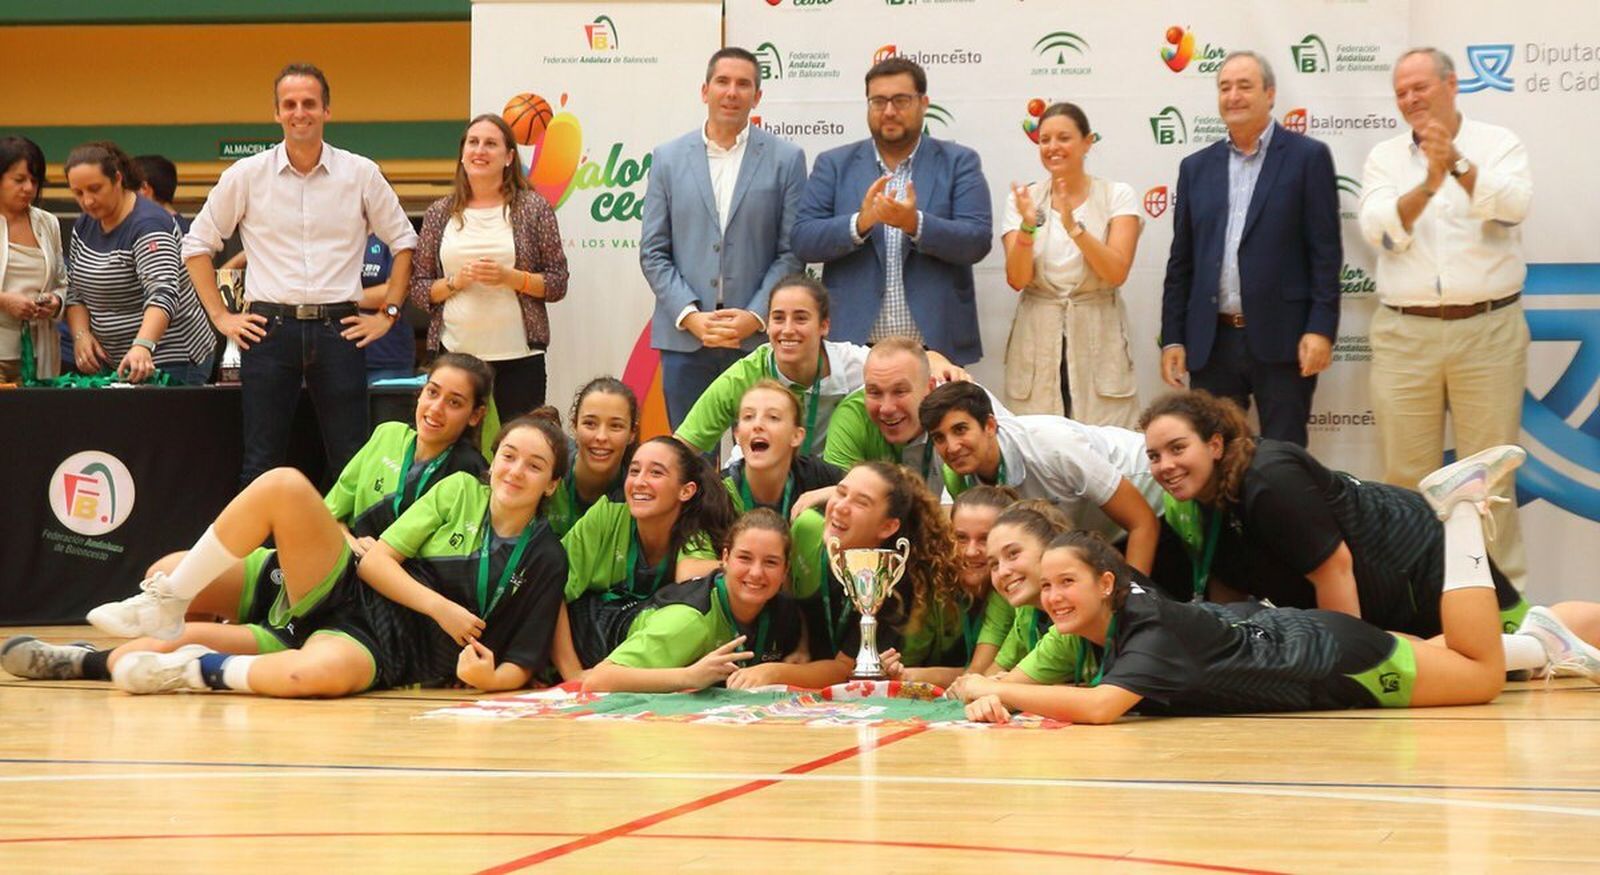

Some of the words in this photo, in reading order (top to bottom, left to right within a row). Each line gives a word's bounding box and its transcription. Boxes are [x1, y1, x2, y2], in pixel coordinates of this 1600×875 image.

[1336, 43, 1380, 53] Federación
[788, 51, 830, 59] Federación
[1336, 54, 1376, 62] Andaluza
[580, 56, 612, 64] Andaluza
[788, 60, 826, 68] Andaluza
[1526, 74, 1551, 93] de
[582, 238, 605, 249] LOS
[611, 238, 641, 249] VAL
